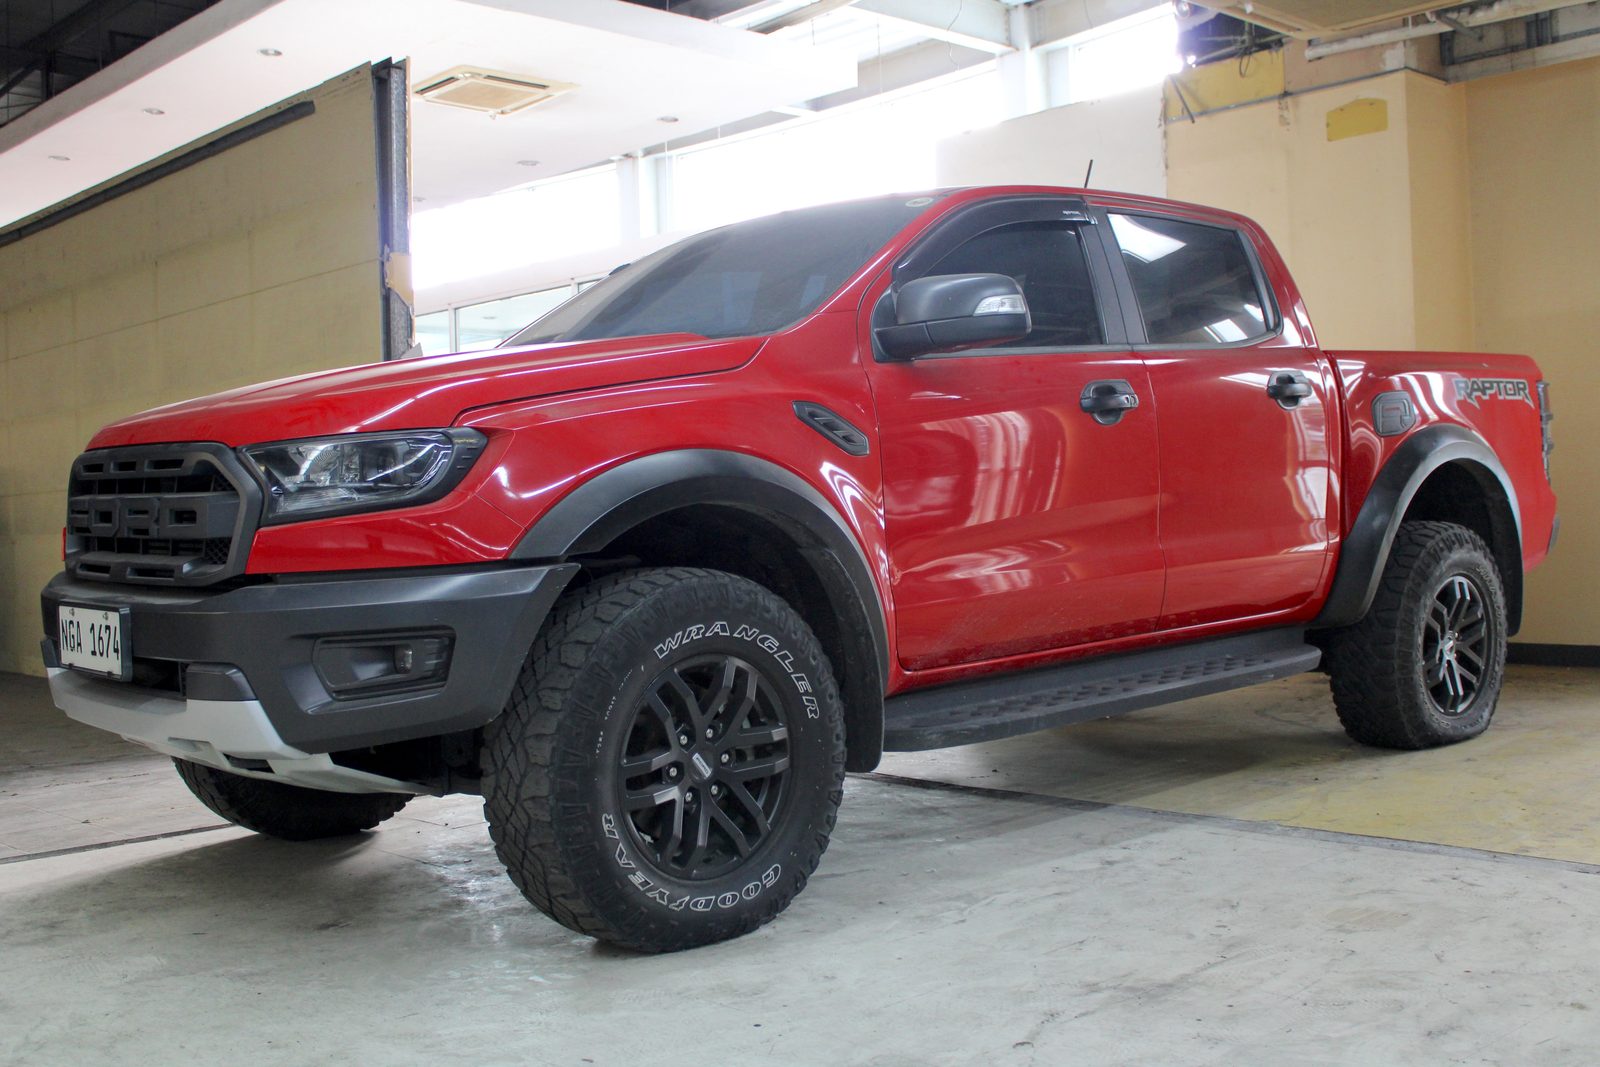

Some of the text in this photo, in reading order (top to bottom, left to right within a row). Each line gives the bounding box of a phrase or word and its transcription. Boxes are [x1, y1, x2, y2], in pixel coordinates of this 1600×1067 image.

[1454, 378, 1535, 410] RAPTOR
[61, 619, 120, 661] NGA 1674
[653, 621, 821, 719] WRANGLER
[602, 813, 782, 911] GOODYEAR
